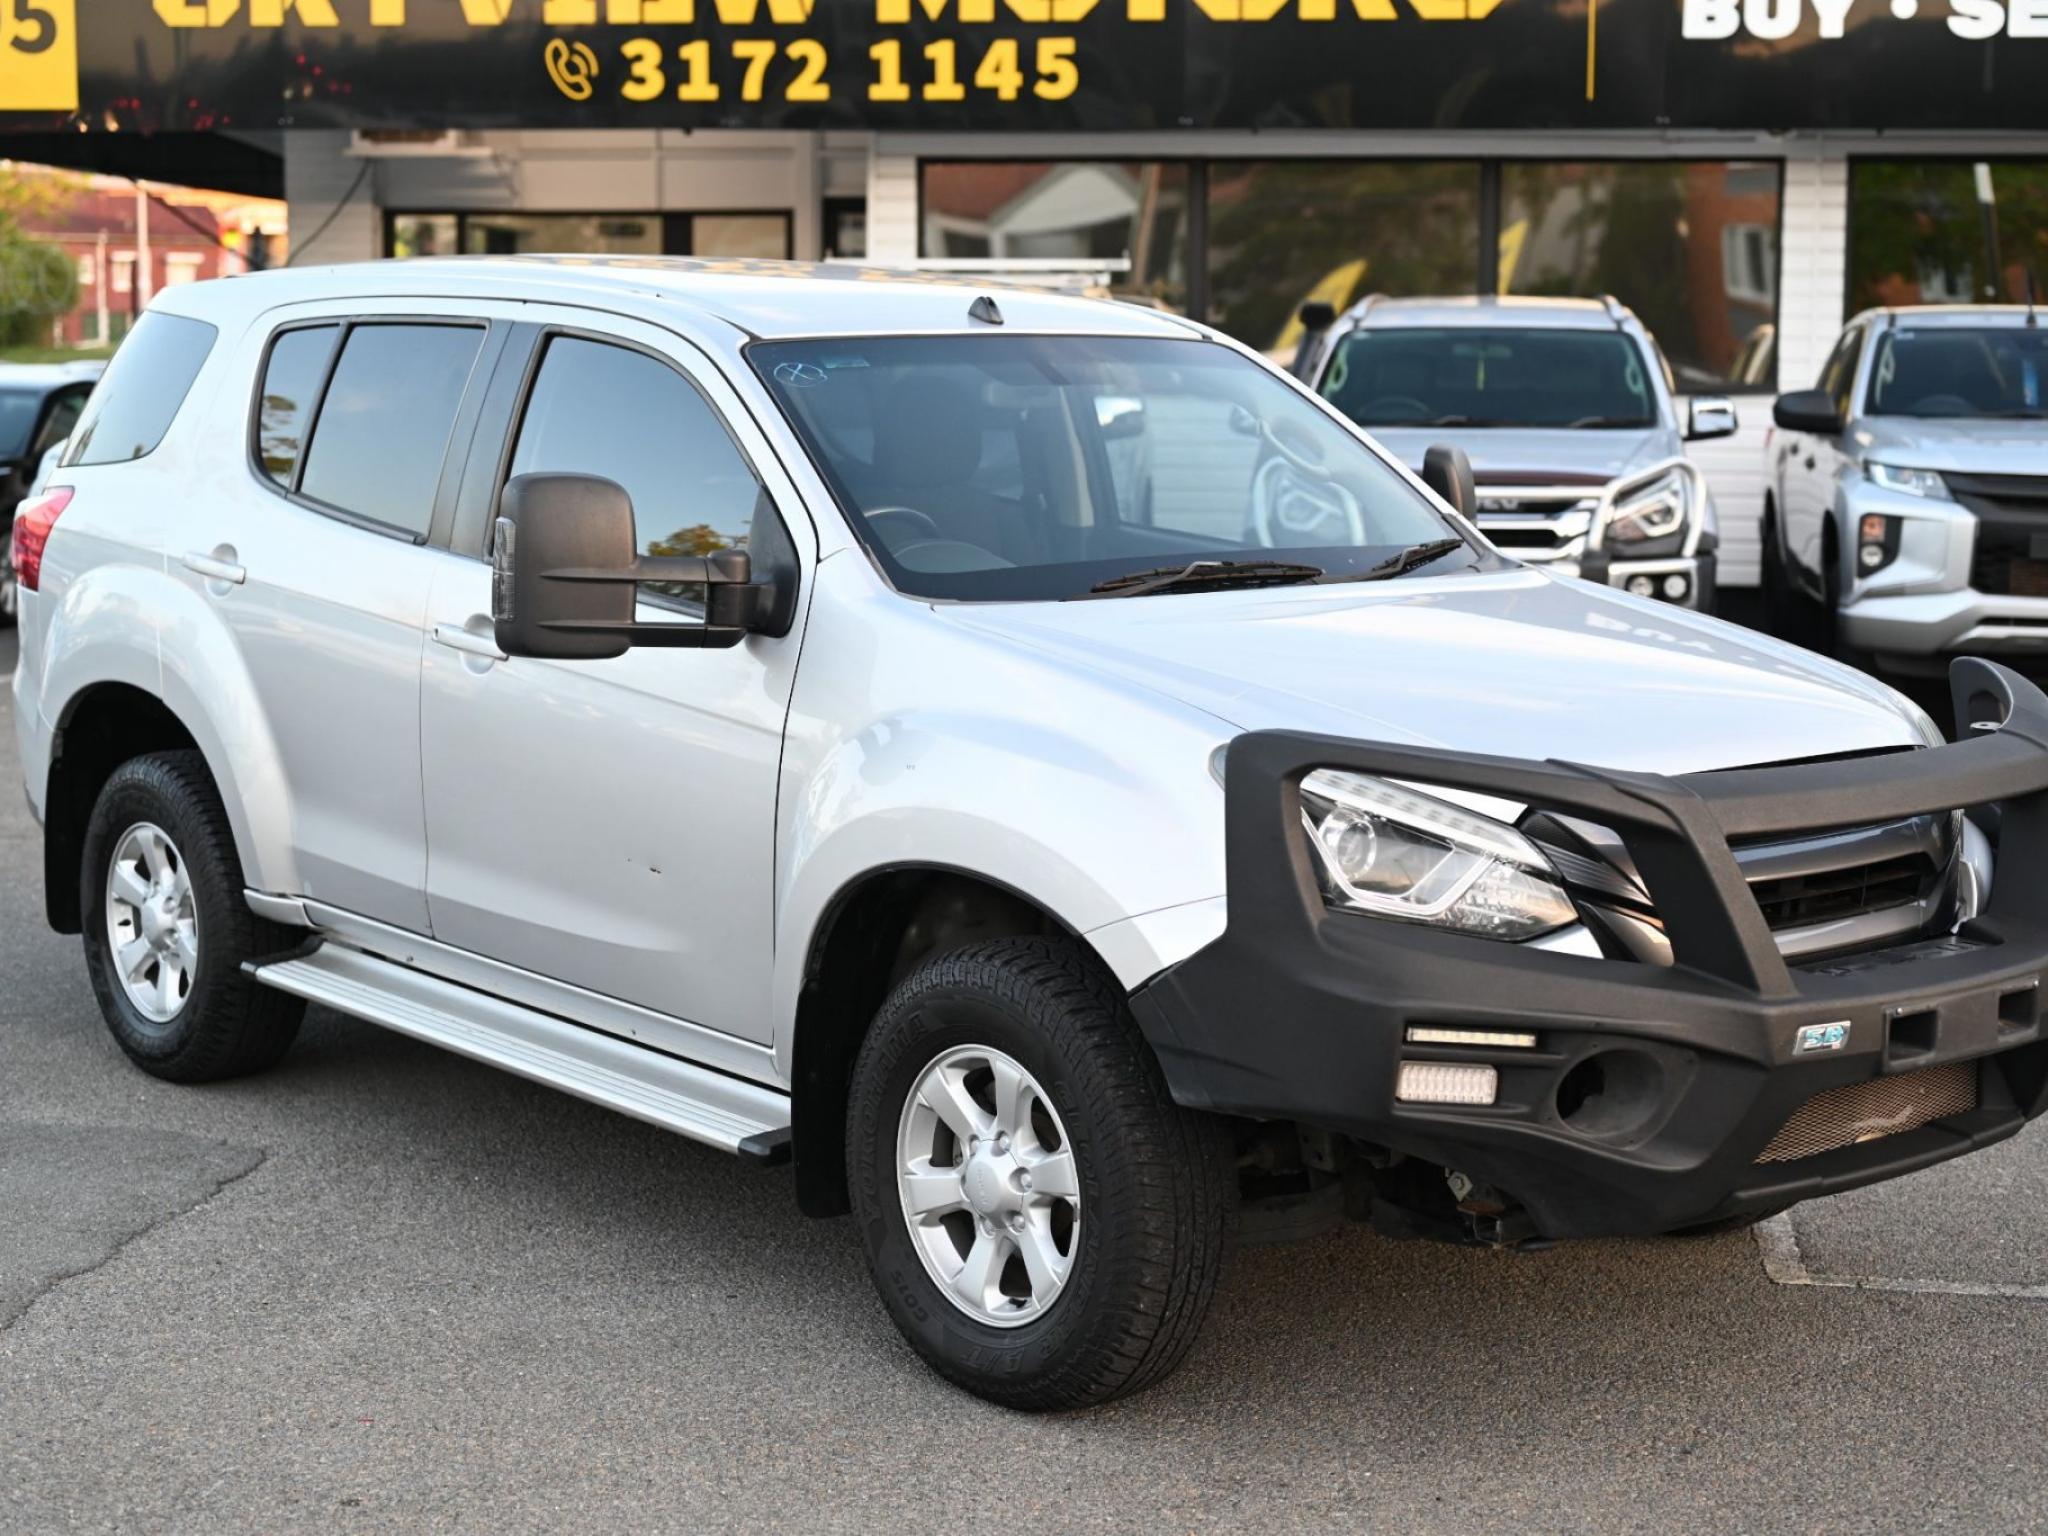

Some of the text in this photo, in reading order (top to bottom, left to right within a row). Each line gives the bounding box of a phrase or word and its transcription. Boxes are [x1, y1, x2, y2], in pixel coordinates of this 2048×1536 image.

[1682, 0, 1855, 40] BUY
[621, 37, 1079, 102] 3172 1145
